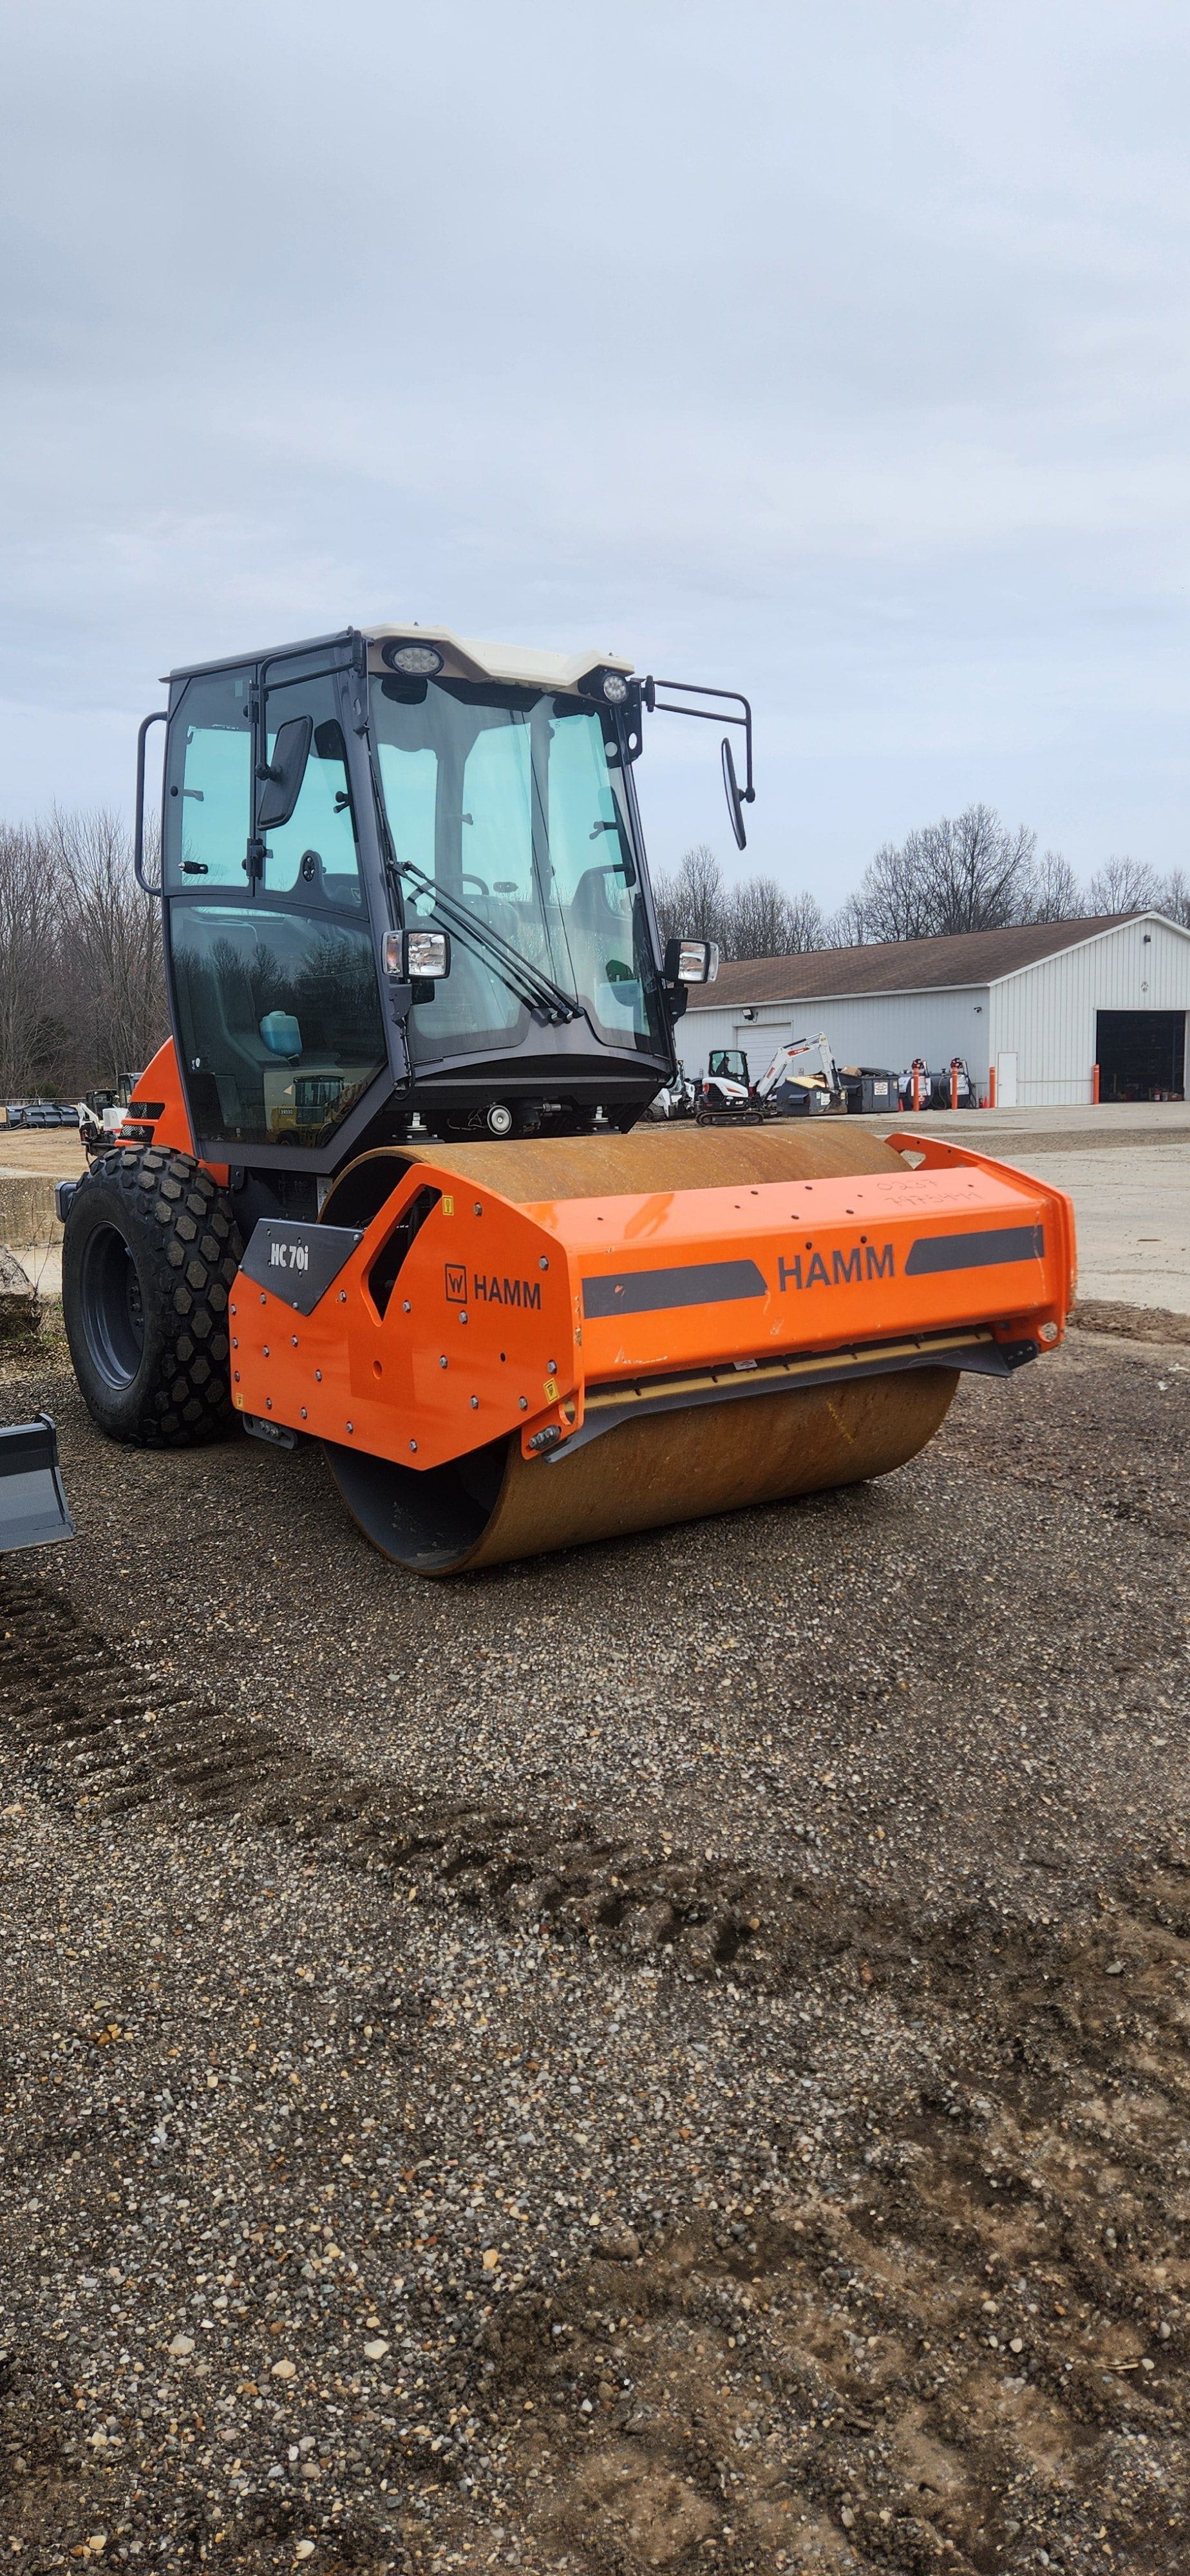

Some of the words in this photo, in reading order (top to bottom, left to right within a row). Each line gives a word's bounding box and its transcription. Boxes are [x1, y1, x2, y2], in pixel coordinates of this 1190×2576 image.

[271, 1243, 287, 1267] HC
[289, 1245, 308, 1271] 70i
[778, 1244, 895, 1292] HAMM
[474, 1274, 541, 1310] HAMM
